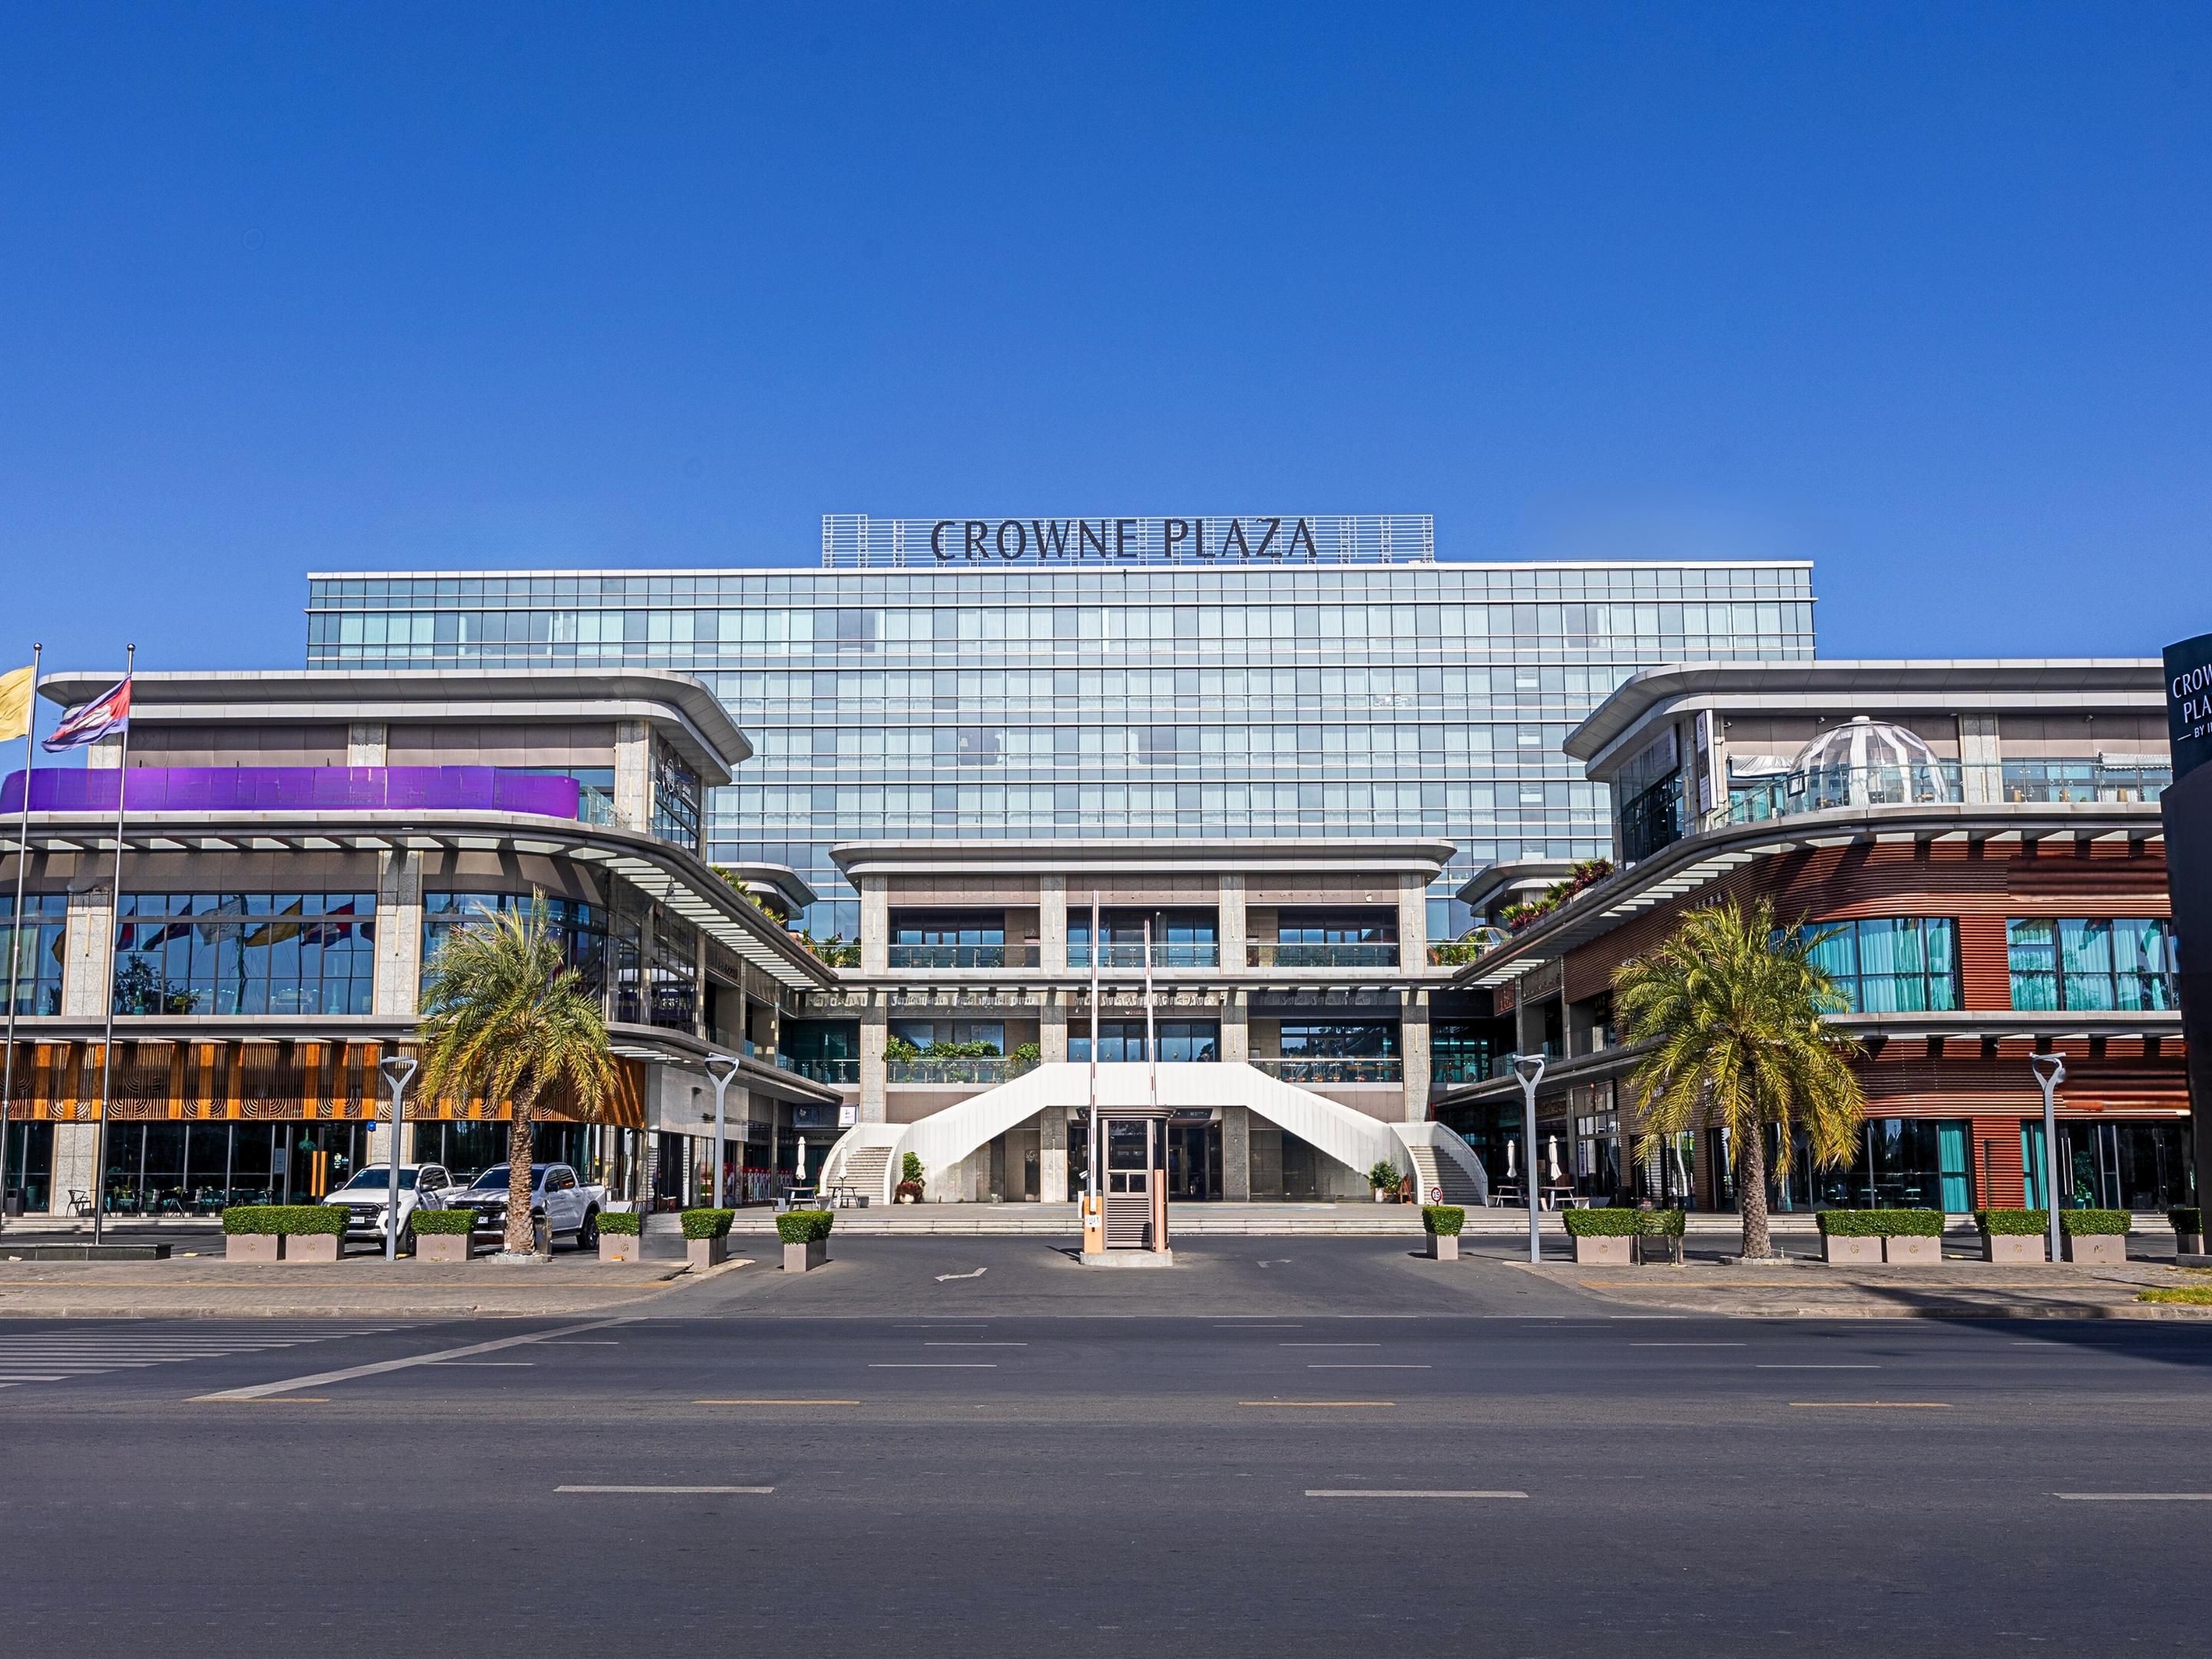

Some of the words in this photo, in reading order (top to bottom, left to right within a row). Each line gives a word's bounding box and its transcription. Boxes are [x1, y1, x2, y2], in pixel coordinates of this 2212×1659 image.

[930, 518, 1138, 561] CROWNE
[1164, 518, 1318, 559] PLAZA
[2194, 725, 2204, 738] BY
